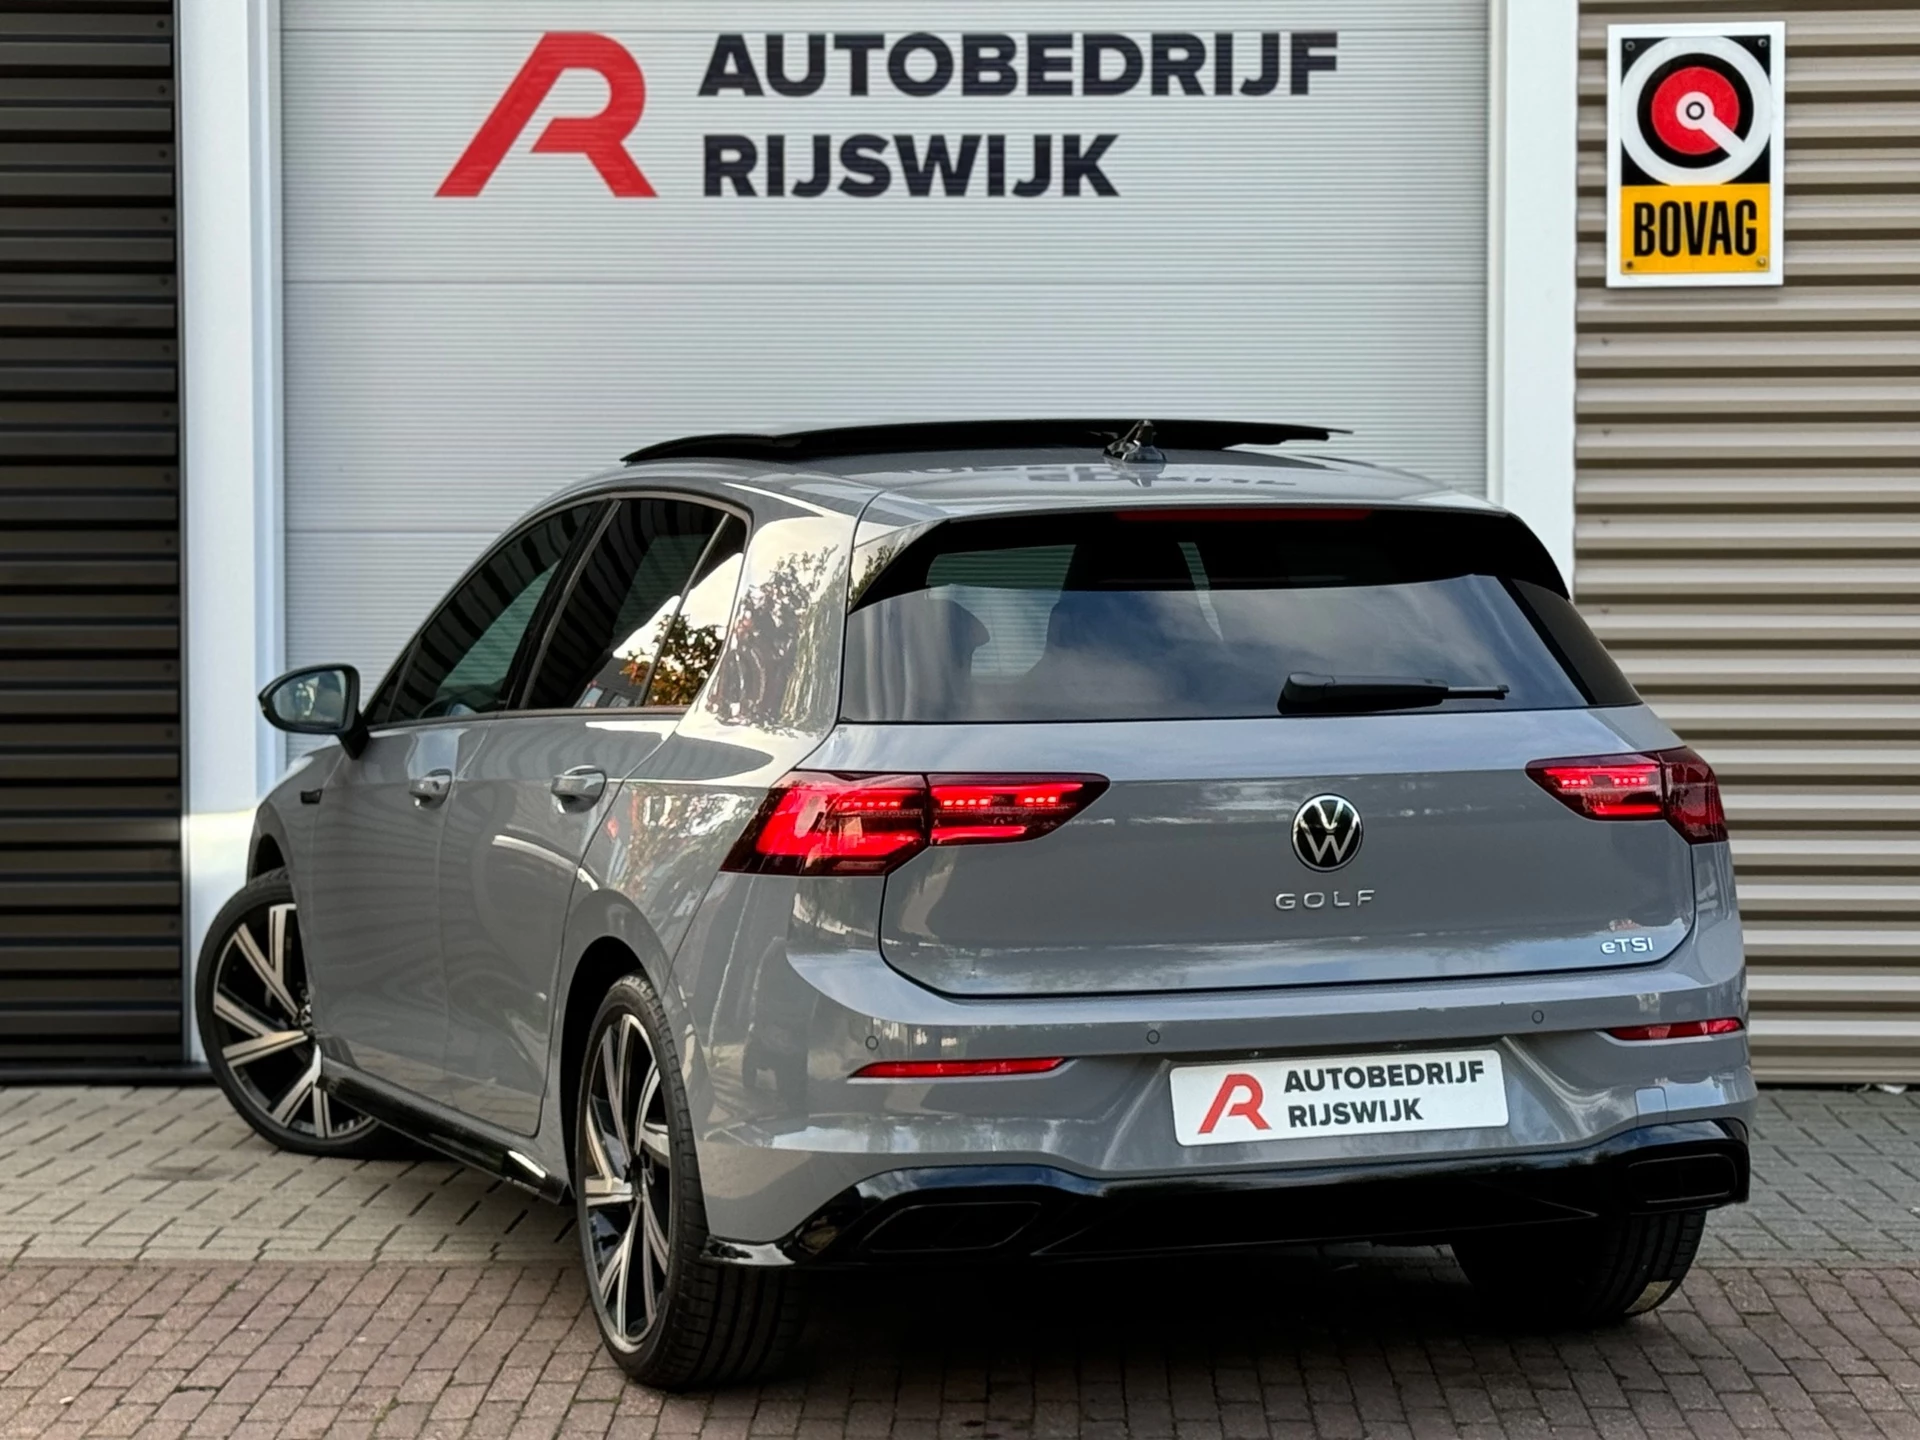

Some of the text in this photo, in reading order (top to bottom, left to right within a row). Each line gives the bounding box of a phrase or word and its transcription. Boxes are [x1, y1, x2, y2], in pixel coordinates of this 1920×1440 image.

[698, 32, 1338, 97] AUTOBEDRIJF
[703, 134, 1120, 197] RIJSWIJK
[1633, 199, 1758, 257] BOVAG
[1275, 889, 1376, 910] GOLF
[1601, 936, 1654, 954] eTSI
[1284, 1060, 1485, 1094] AUTOBEDRIJF
[1287, 1097, 1424, 1128] RIJSWIJK
